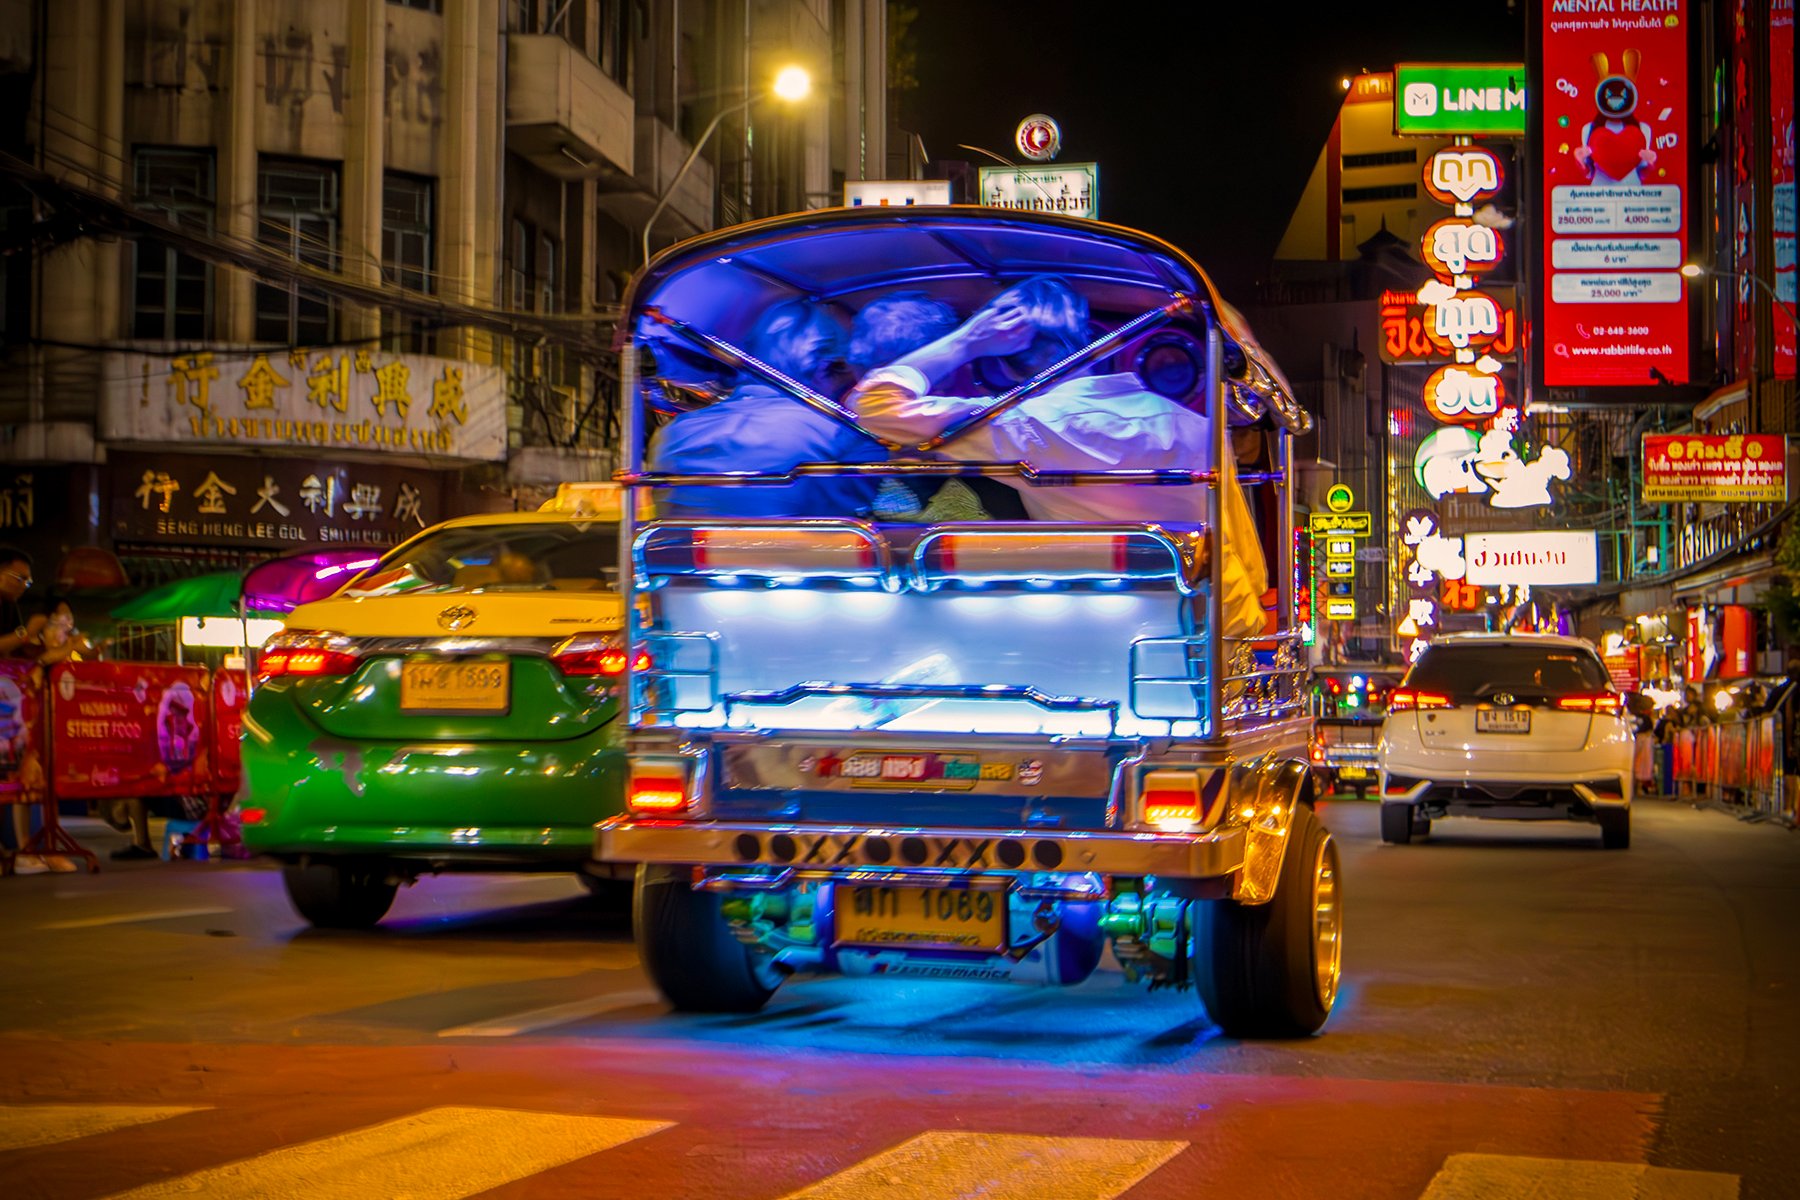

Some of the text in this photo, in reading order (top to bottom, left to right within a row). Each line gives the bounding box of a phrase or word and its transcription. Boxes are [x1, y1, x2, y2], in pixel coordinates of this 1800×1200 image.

[1552, 0, 1678, 12] MENTAL HEALTH
[1556, 78, 1579, 98] OPD
[1443, 87, 1502, 111] LINE
[1655, 132, 1678, 150] IPD
[1558, 216, 1594, 226] 250,000
[1624, 215, 1650, 225] 4,000
[1591, 289, 1621, 298] 25,000
[1571, 344, 1673, 355] www.rabbitlife.co.th
[157, 519, 199, 535] SENG
[247, 523, 276, 539] LEE
[66, 719, 110, 738] STREET
